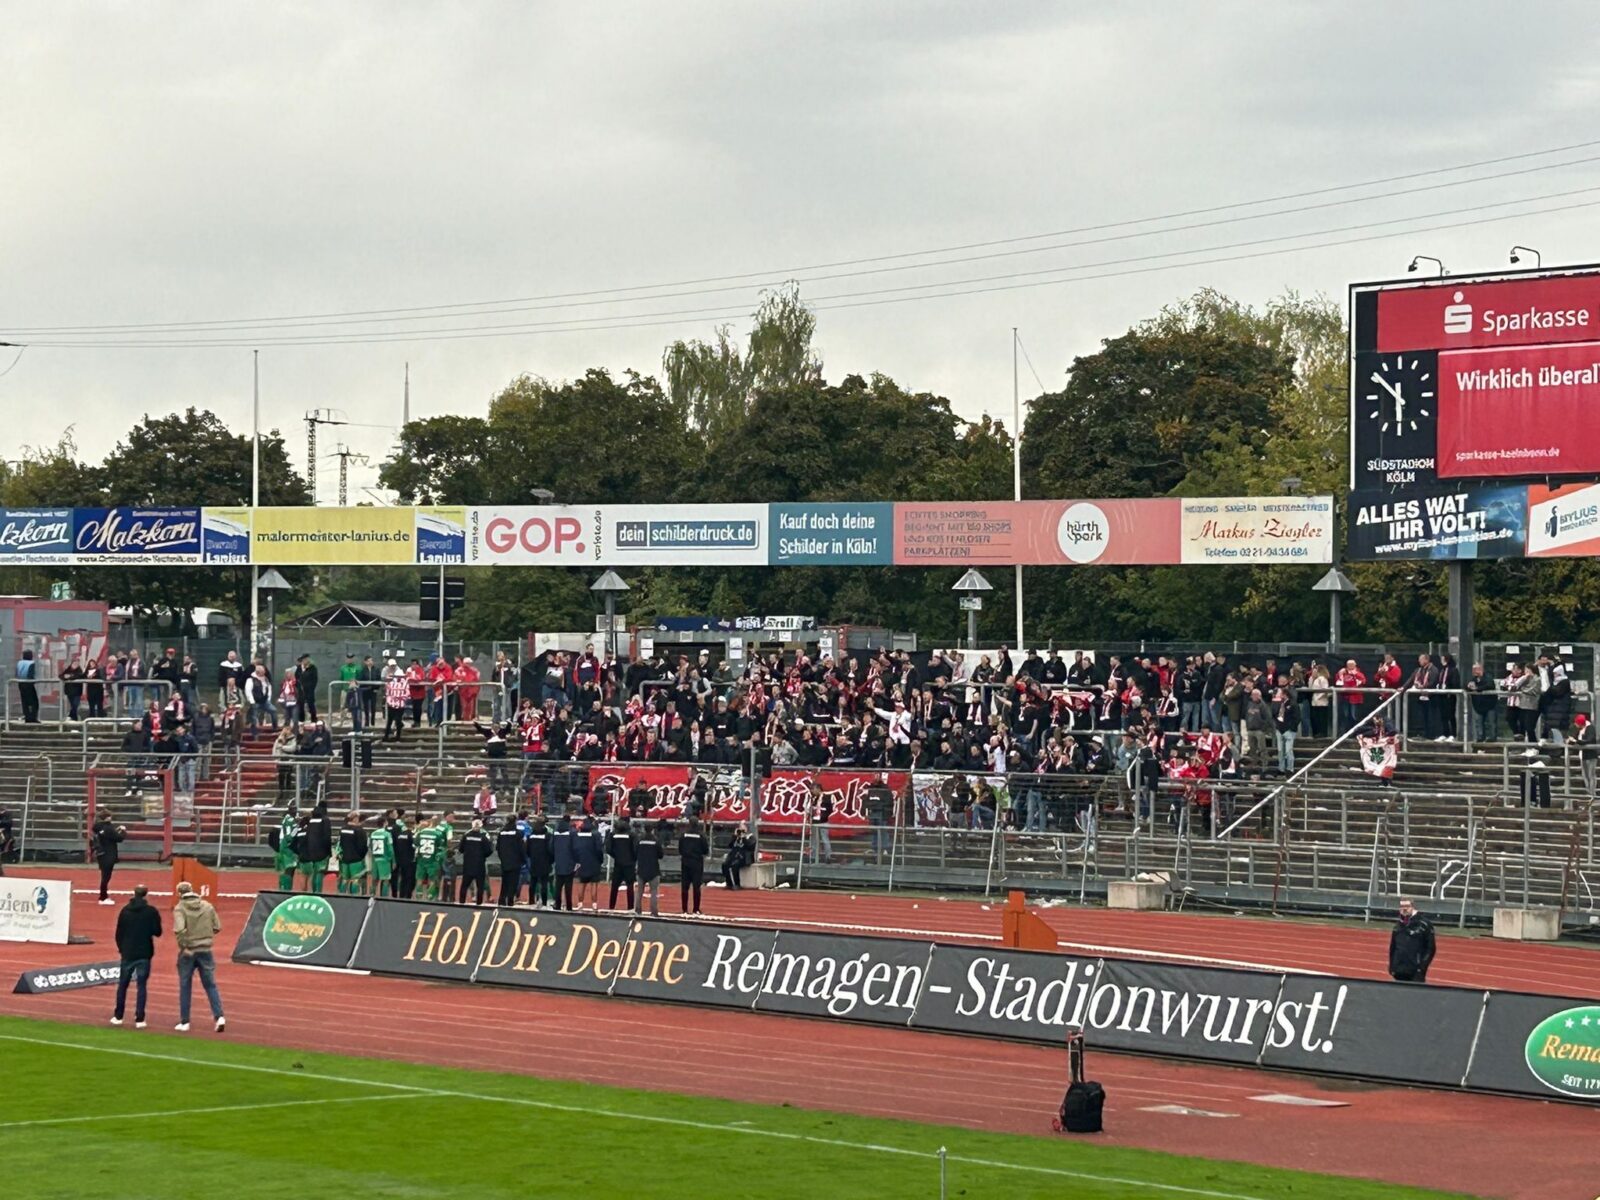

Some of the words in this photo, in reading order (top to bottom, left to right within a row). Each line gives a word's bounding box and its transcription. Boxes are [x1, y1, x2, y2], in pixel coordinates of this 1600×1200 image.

[1482, 306, 1589, 336] Sparkasse
[1456, 367, 1533, 391] Wirklich
[1538, 362, 1600, 387] überal
[1367, 457, 1434, 471] SÜDSTADION
[1386, 471, 1415, 483] KÖLN
[1356, 500, 1420, 526] ALLES
[1425, 493, 1469, 515] WAT
[76, 508, 198, 552] Malzkorn
[779, 513, 807, 530] Kauf
[810, 512, 840, 530] doch
[842, 511, 876, 529] deine
[1190, 519, 1256, 542] Markus
[1259, 518, 1323, 542] Ziegler
[1389, 518, 1424, 541] IHR
[1429, 510, 1487, 535] VOLT!
[257, 529, 410, 543] malermeister-lanius.de
[619, 524, 645, 542] dein
[651, 523, 753, 542] schilderdruck.de
[1070, 532, 1102, 545] park
[779, 537, 829, 555] Schilder
[832, 537, 843, 554] in
[846, 536, 878, 555] Köln!
[403, 910, 479, 966] Hol
[481, 916, 556, 971] Dir
[557, 920, 690, 985] Deine
[1561, 1074, 1582, 1088] SEIT
